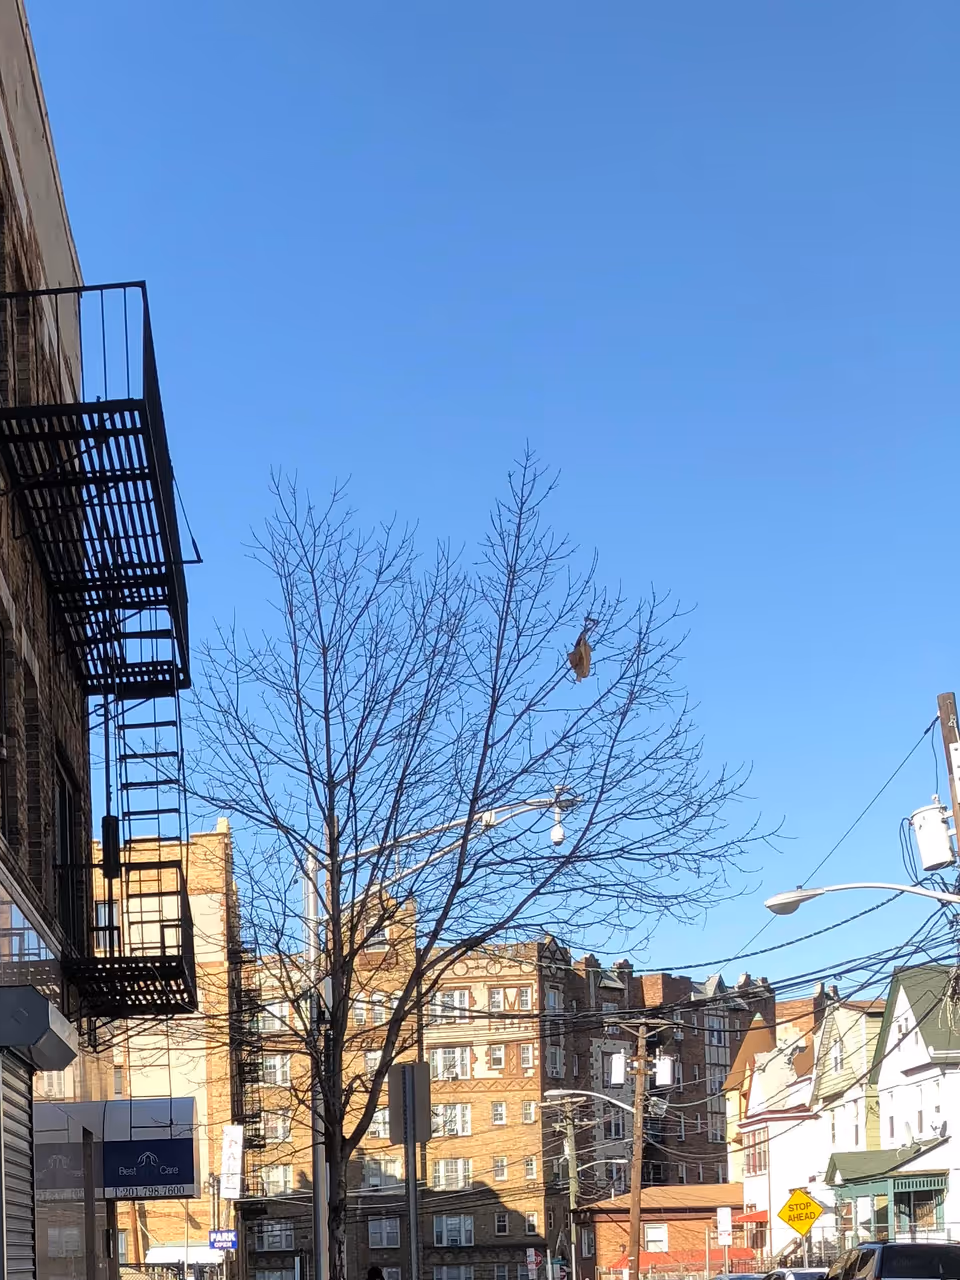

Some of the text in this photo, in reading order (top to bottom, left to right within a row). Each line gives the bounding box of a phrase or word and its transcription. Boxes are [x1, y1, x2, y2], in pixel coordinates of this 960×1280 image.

[118, 1165, 179, 1176] Best Care
[788, 1202, 811, 1212] STOP
[787, 1211, 815, 1222] AHEAD
[210, 1232, 236, 1242] PARK
